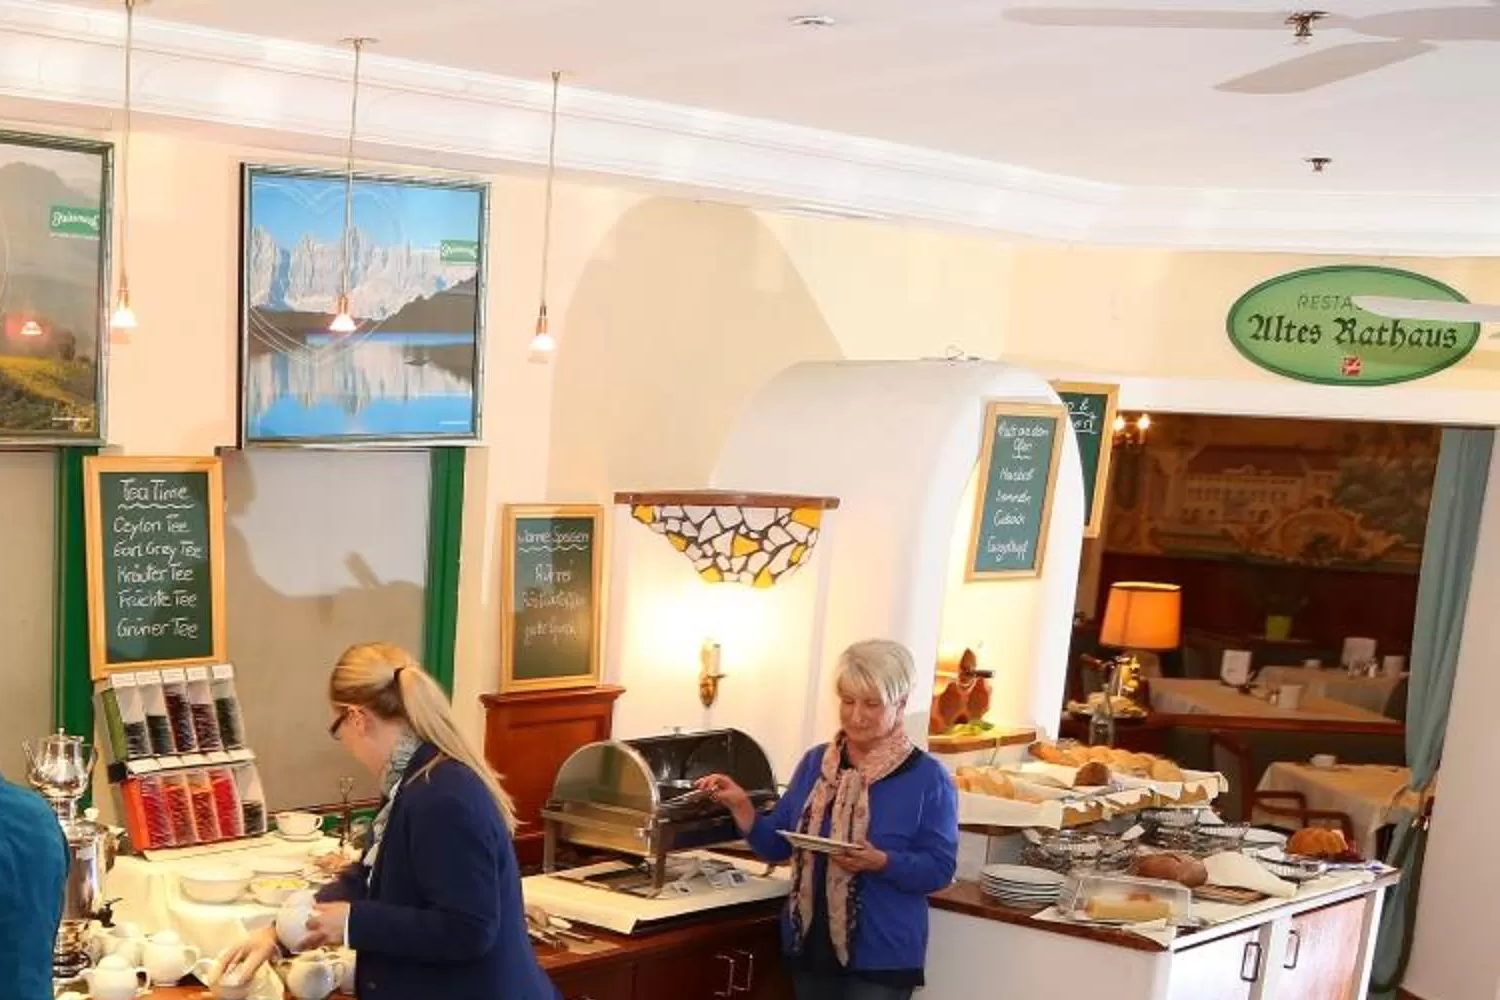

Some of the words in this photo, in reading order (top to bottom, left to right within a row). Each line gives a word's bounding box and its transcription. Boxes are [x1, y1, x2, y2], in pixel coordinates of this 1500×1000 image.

[1248, 313, 1322, 345] Altes
[1333, 317, 1457, 350] Rathaus
[120, 478, 149, 501] Tea
[150, 479, 191, 501] Time
[113, 516, 161, 540] Ceylon
[165, 513, 191, 533] Tee
